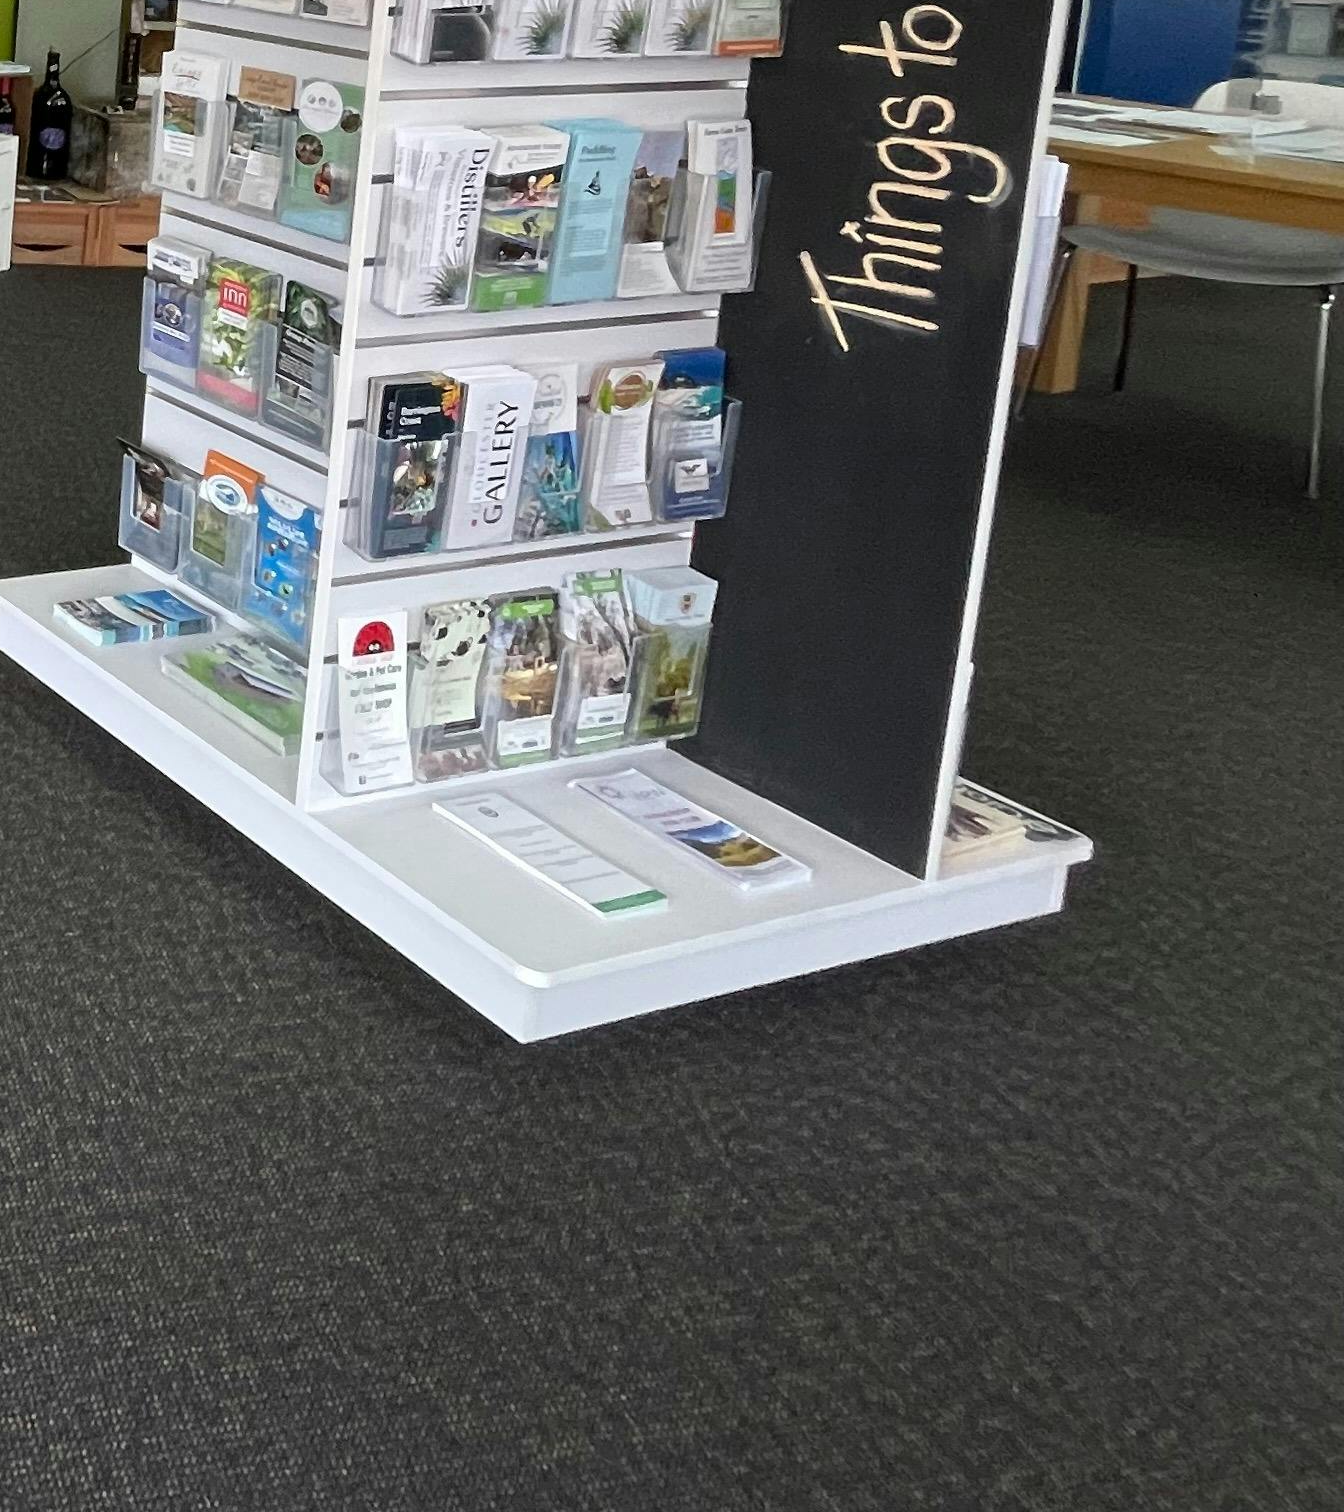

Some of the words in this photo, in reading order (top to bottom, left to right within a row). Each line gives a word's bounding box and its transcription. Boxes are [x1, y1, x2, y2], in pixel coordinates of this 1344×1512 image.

[838, 3, 964, 78] to
[455, 148, 490, 248] Distillers
[800, 94, 1013, 353] Things
[483, 400, 519, 525] GALLERY
